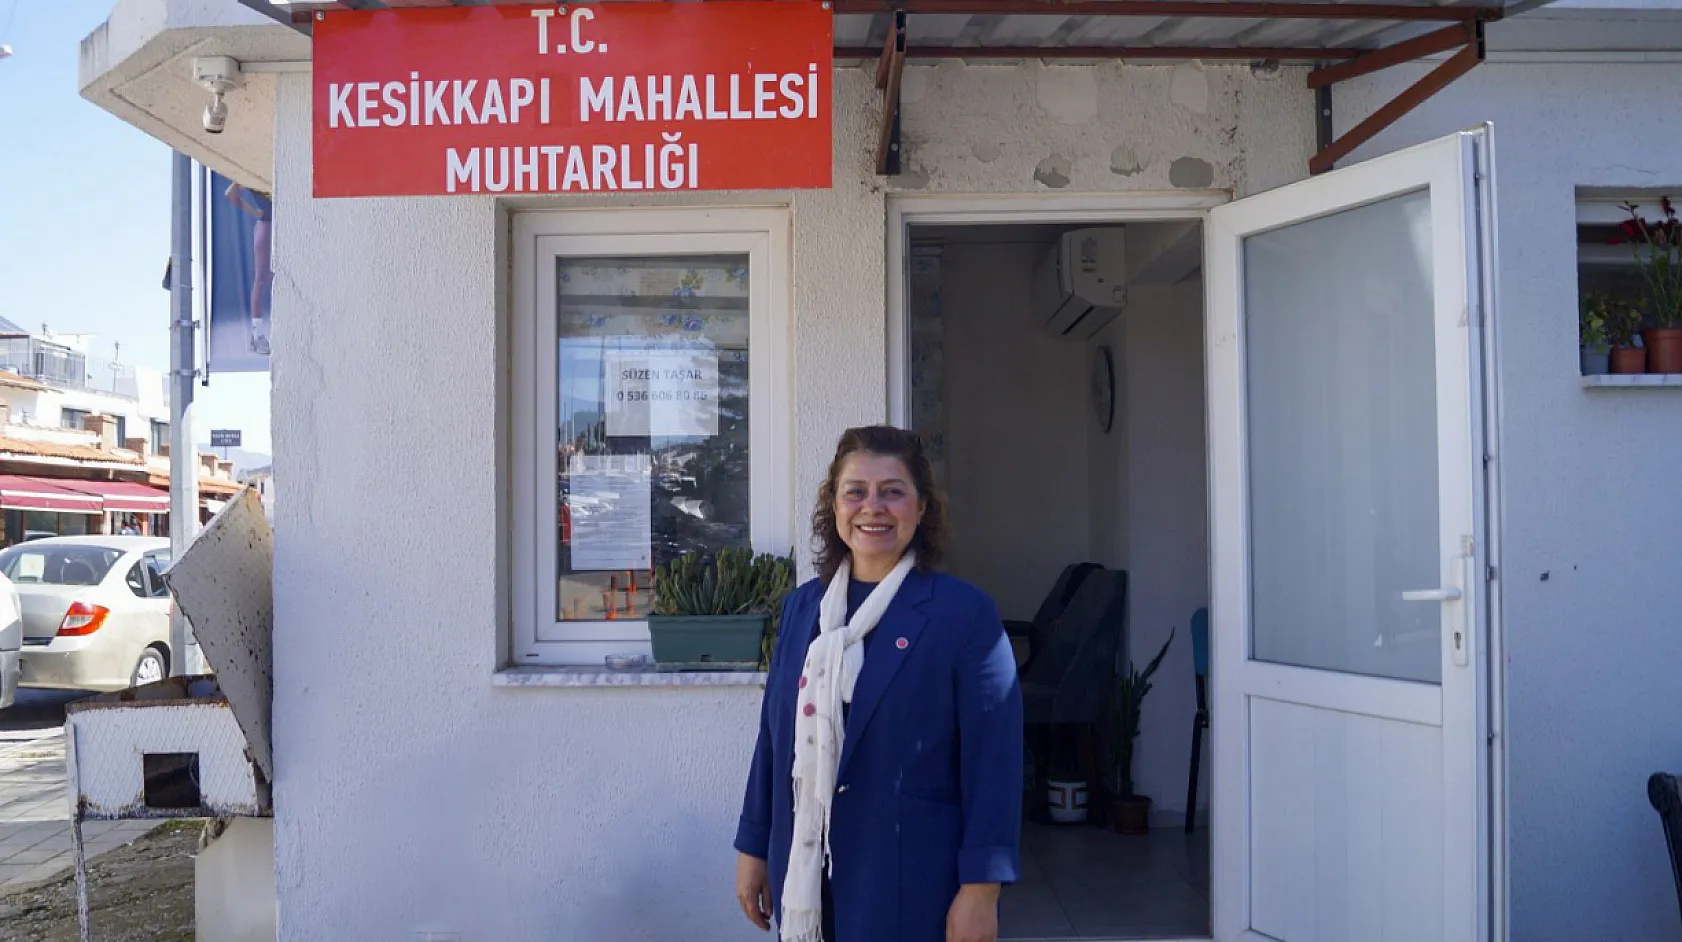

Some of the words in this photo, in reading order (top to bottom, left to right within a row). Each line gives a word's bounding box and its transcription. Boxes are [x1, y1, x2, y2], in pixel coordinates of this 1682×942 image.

[530, 7, 608, 55] T.C.
[328, 71, 550, 128] KESİKKAPI
[580, 63, 818, 122] MAHALLESİ
[446, 131, 698, 193] MUHTARLIĞI
[617, 390, 624, 401] 0
[627, 390, 648, 401] 536
[622, 368, 660, 380] SÜZEN
[663, 369, 702, 382] TAŞAR
